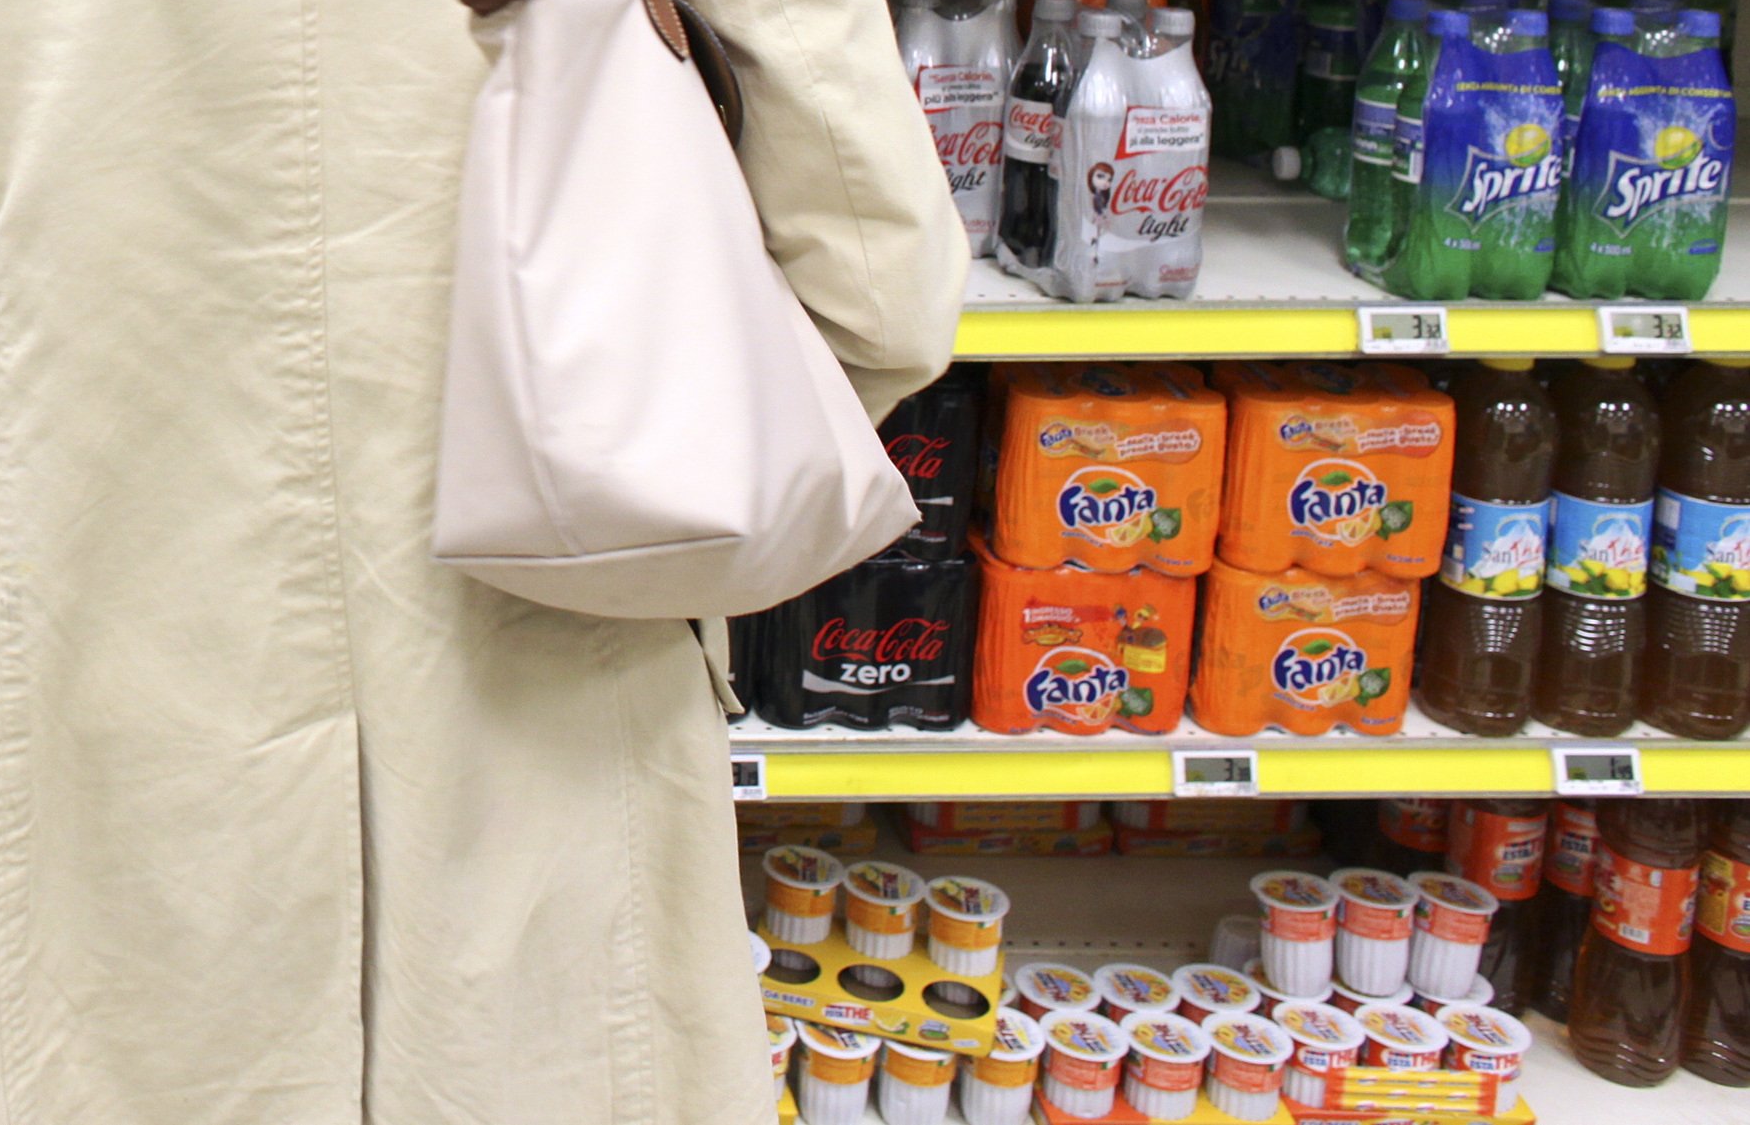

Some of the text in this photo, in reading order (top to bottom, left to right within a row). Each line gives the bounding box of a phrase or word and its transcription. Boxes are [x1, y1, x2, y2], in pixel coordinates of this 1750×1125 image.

[1463, 151, 1562, 223] Sprite
[1606, 150, 1723, 225] Sprite
[1138, 215, 1188, 242] light
[1058, 484, 1156, 528] Fanta
[1289, 479, 1388, 526] Fanta
[812, 617, 952, 662] Coca-Cola
[840, 662, 912, 686] zero
[1027, 666, 1130, 712] Fanta
[1274, 647, 1366, 691] Fanta
